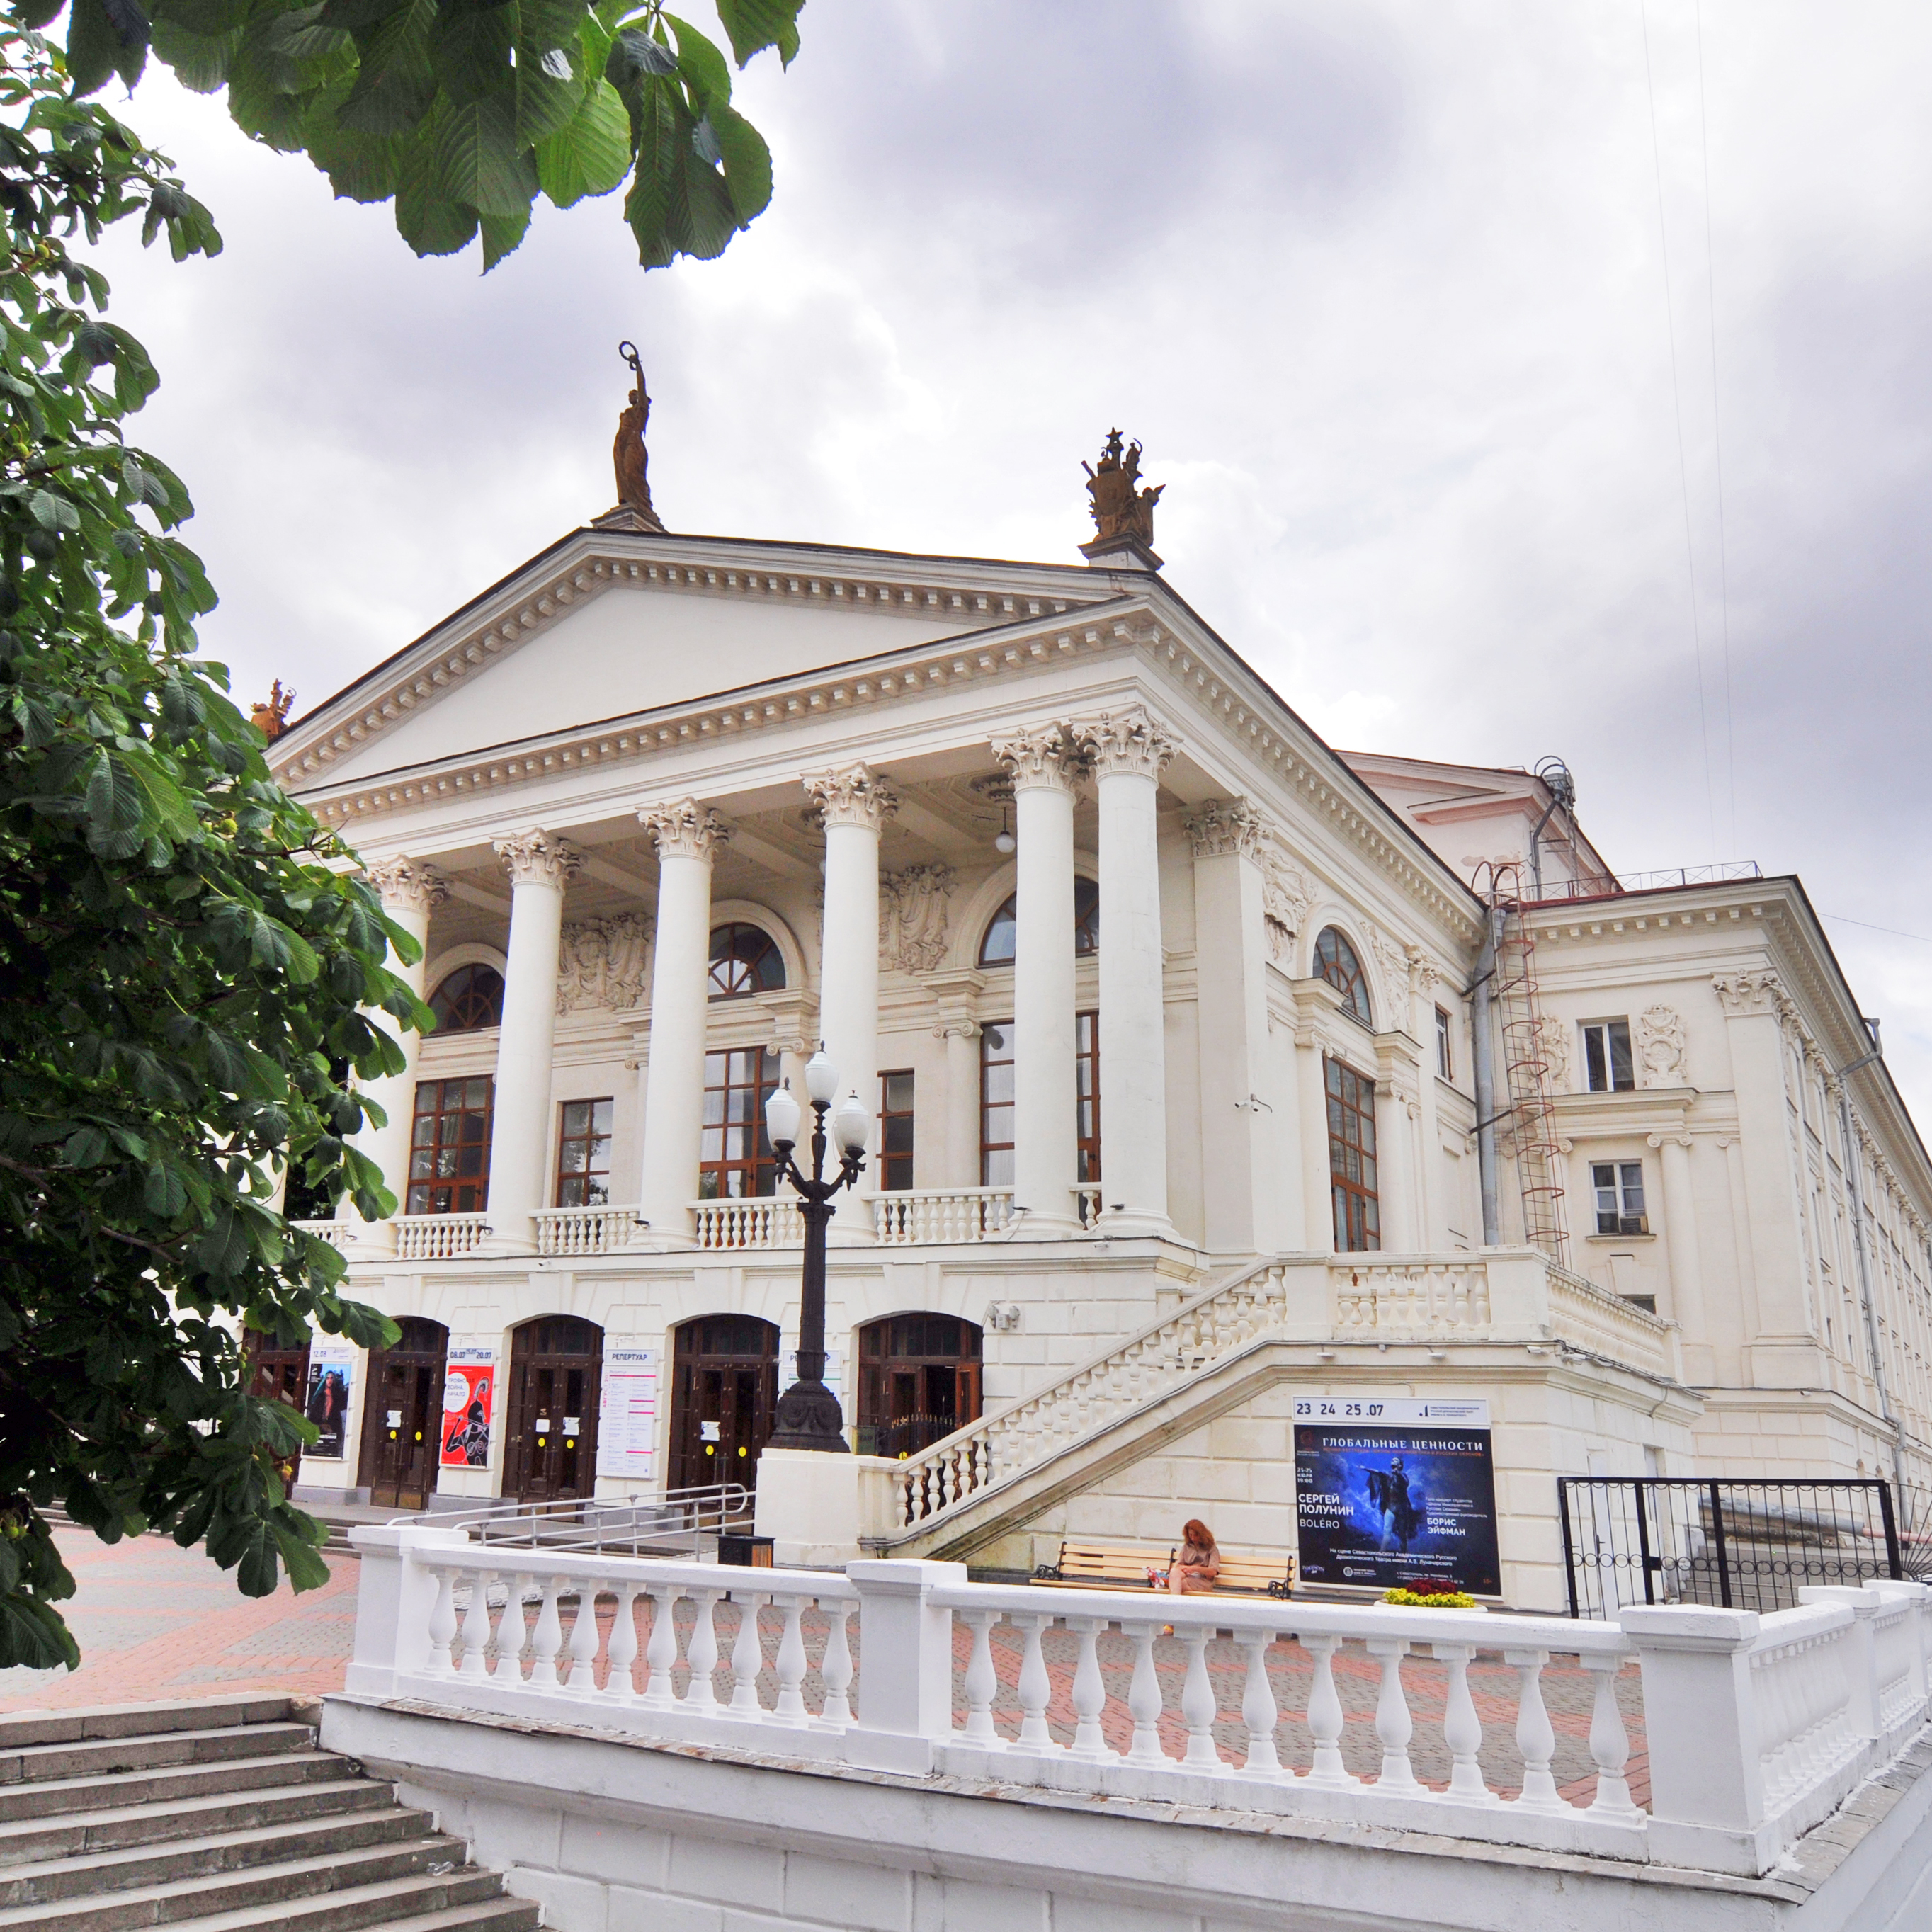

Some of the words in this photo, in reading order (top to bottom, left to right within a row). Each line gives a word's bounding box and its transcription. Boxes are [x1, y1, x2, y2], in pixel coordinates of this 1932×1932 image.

[1297, 1403, 1311, 1414] 23
[1320, 1404, 1336, 1414] 24
[1322, 1438, 1407, 1449] ГЛОБАЛЬНЫЕ
[1411, 1440, 1482, 1451] ЦЕННОСТИ
[1298, 1493, 1339, 1504] СЕРГЕЙ
[1299, 1504, 1354, 1516] ПОЛУНИН
[1426, 1518, 1457, 1526] БОРИС
[1428, 1526, 1466, 1535] ЭЙФМАН
